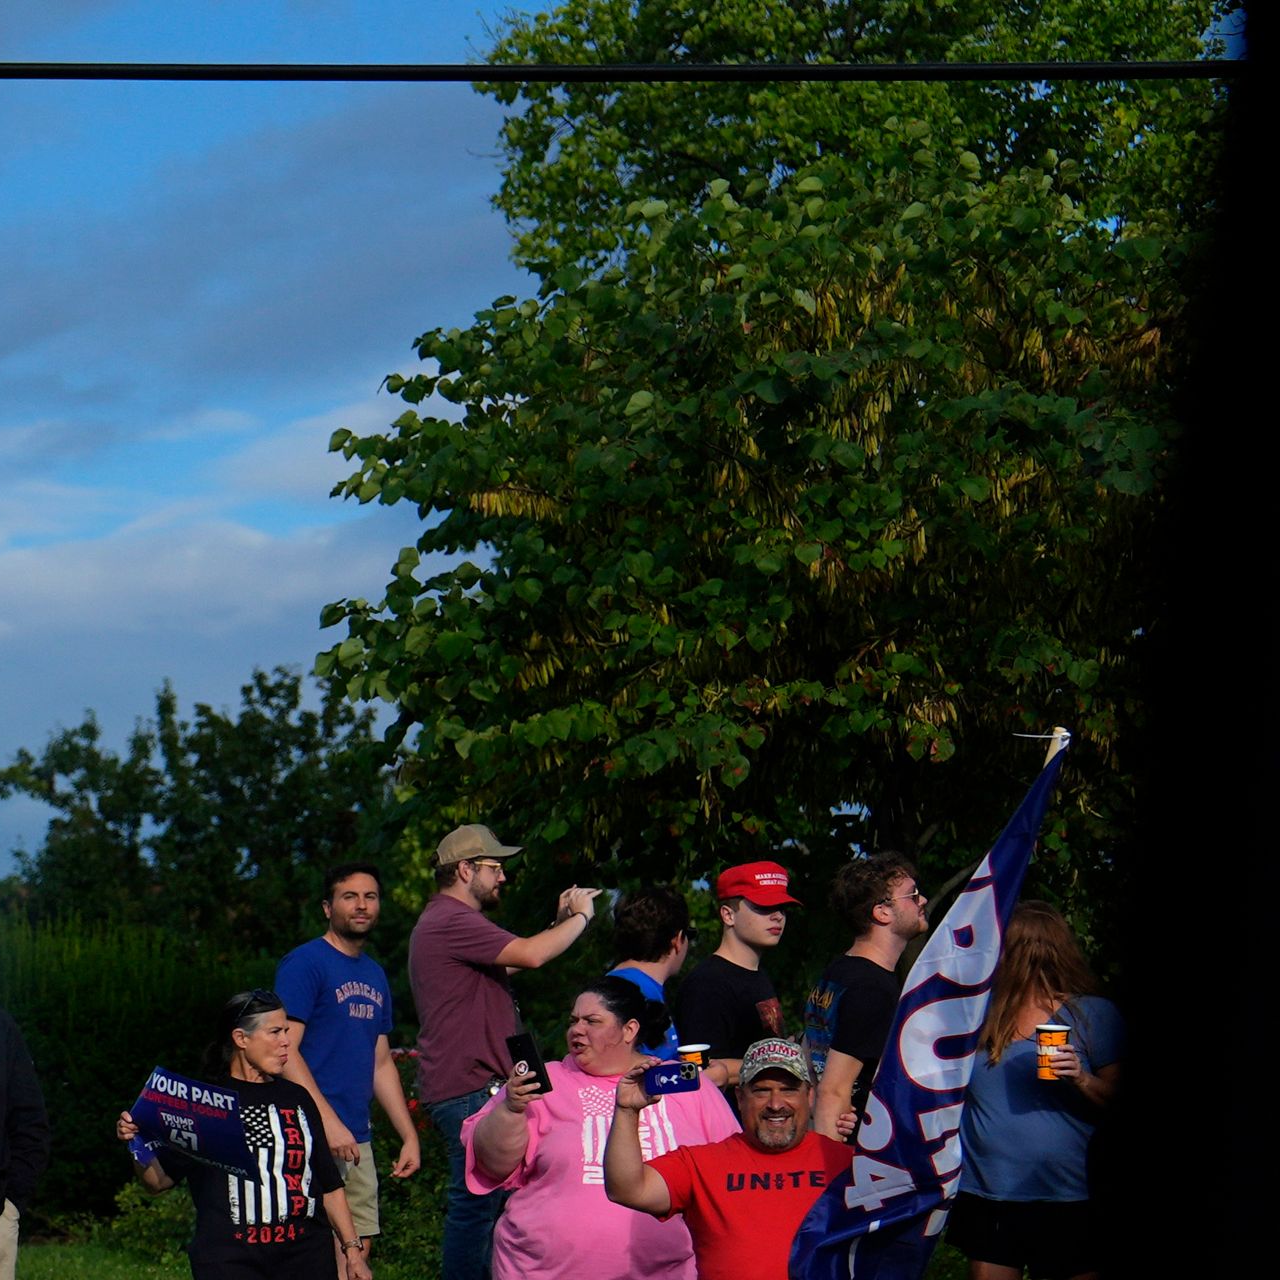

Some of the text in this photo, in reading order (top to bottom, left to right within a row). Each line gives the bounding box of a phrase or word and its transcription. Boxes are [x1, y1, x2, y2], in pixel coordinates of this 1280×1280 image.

[151, 1073, 235, 1110] YOUR PART
[160, 1111, 194, 1126] TRUMP
[280, 1108, 307, 1217] TRUMP
[247, 1224, 296, 1244] 2024
